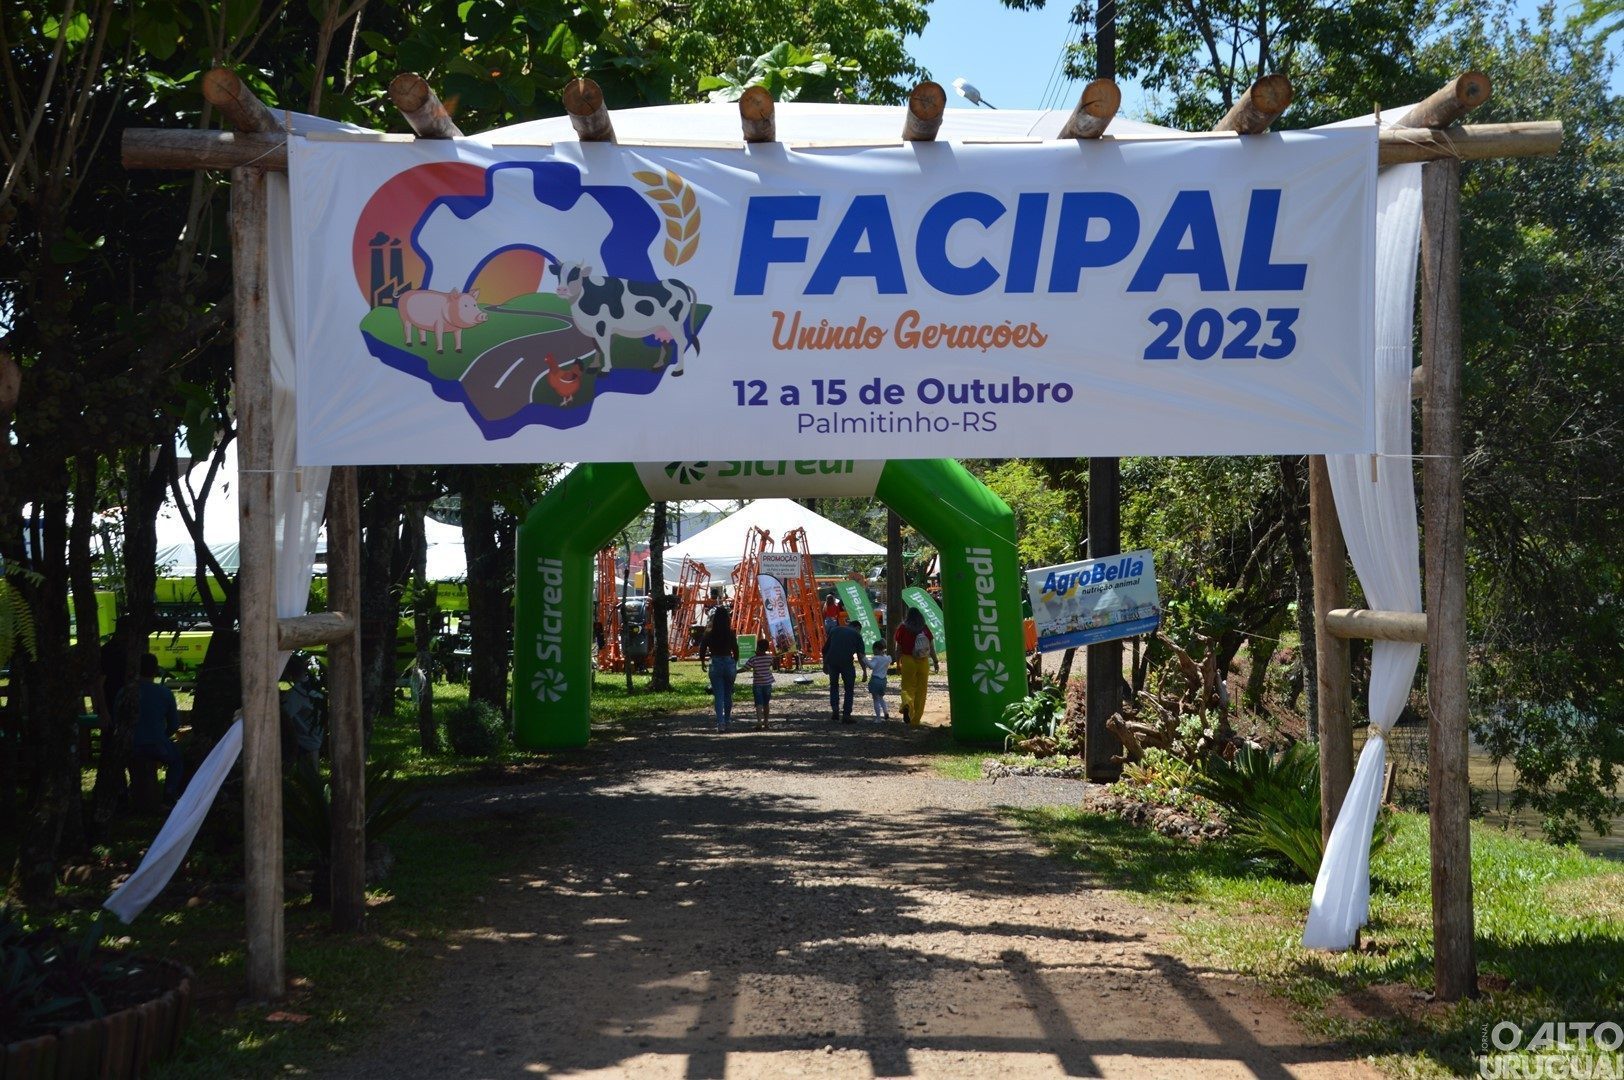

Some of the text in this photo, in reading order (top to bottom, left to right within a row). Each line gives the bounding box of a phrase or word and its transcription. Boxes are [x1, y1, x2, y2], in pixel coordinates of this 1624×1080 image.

[733, 188, 1309, 296] FACIPAL
[771, 309, 1049, 353] Unindo Gerações
[1142, 306, 1301, 361] 2023
[732, 375, 1075, 407] 12 a 15 de Outubro
[797, 411, 998, 434] Palmitinho-RS
[1041, 557, 1144, 596] AgroBella
[1081, 577, 1141, 596] nutrição animal
[537, 557, 563, 663] Sicredi
[965, 547, 1001, 652] Sicredi
